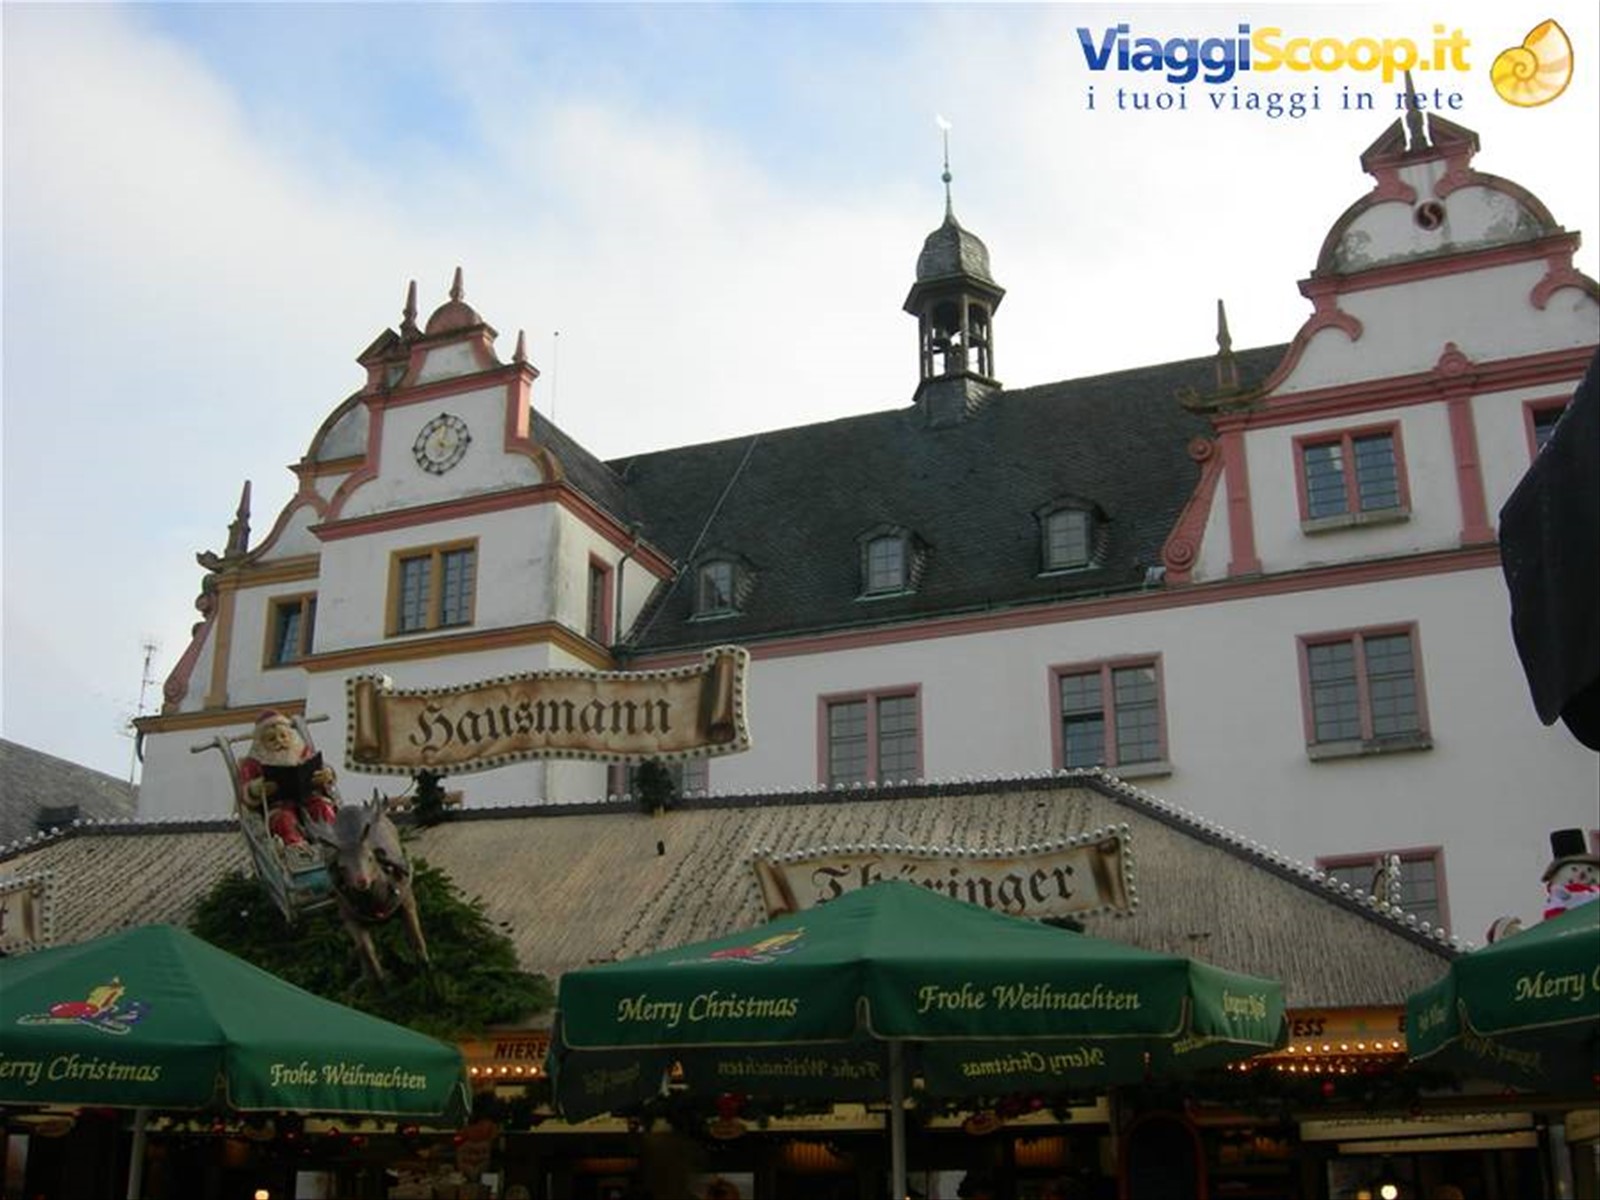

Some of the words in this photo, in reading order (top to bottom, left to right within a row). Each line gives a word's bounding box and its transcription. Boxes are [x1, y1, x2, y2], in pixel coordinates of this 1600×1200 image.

[409, 696, 672, 760] Hausmann
[917, 983, 988, 1013] Frohe
[991, 982, 1141, 1011] Weihnachten
[1514, 970, 1586, 1002] Merry
[616, 994, 682, 1028] Merry
[688, 990, 800, 1021] Christmas
[0, 1052, 43, 1086] erry
[47, 1052, 162, 1082] Christmas
[270, 1062, 318, 1087] Frohe
[321, 1062, 427, 1090] Weihnachten
